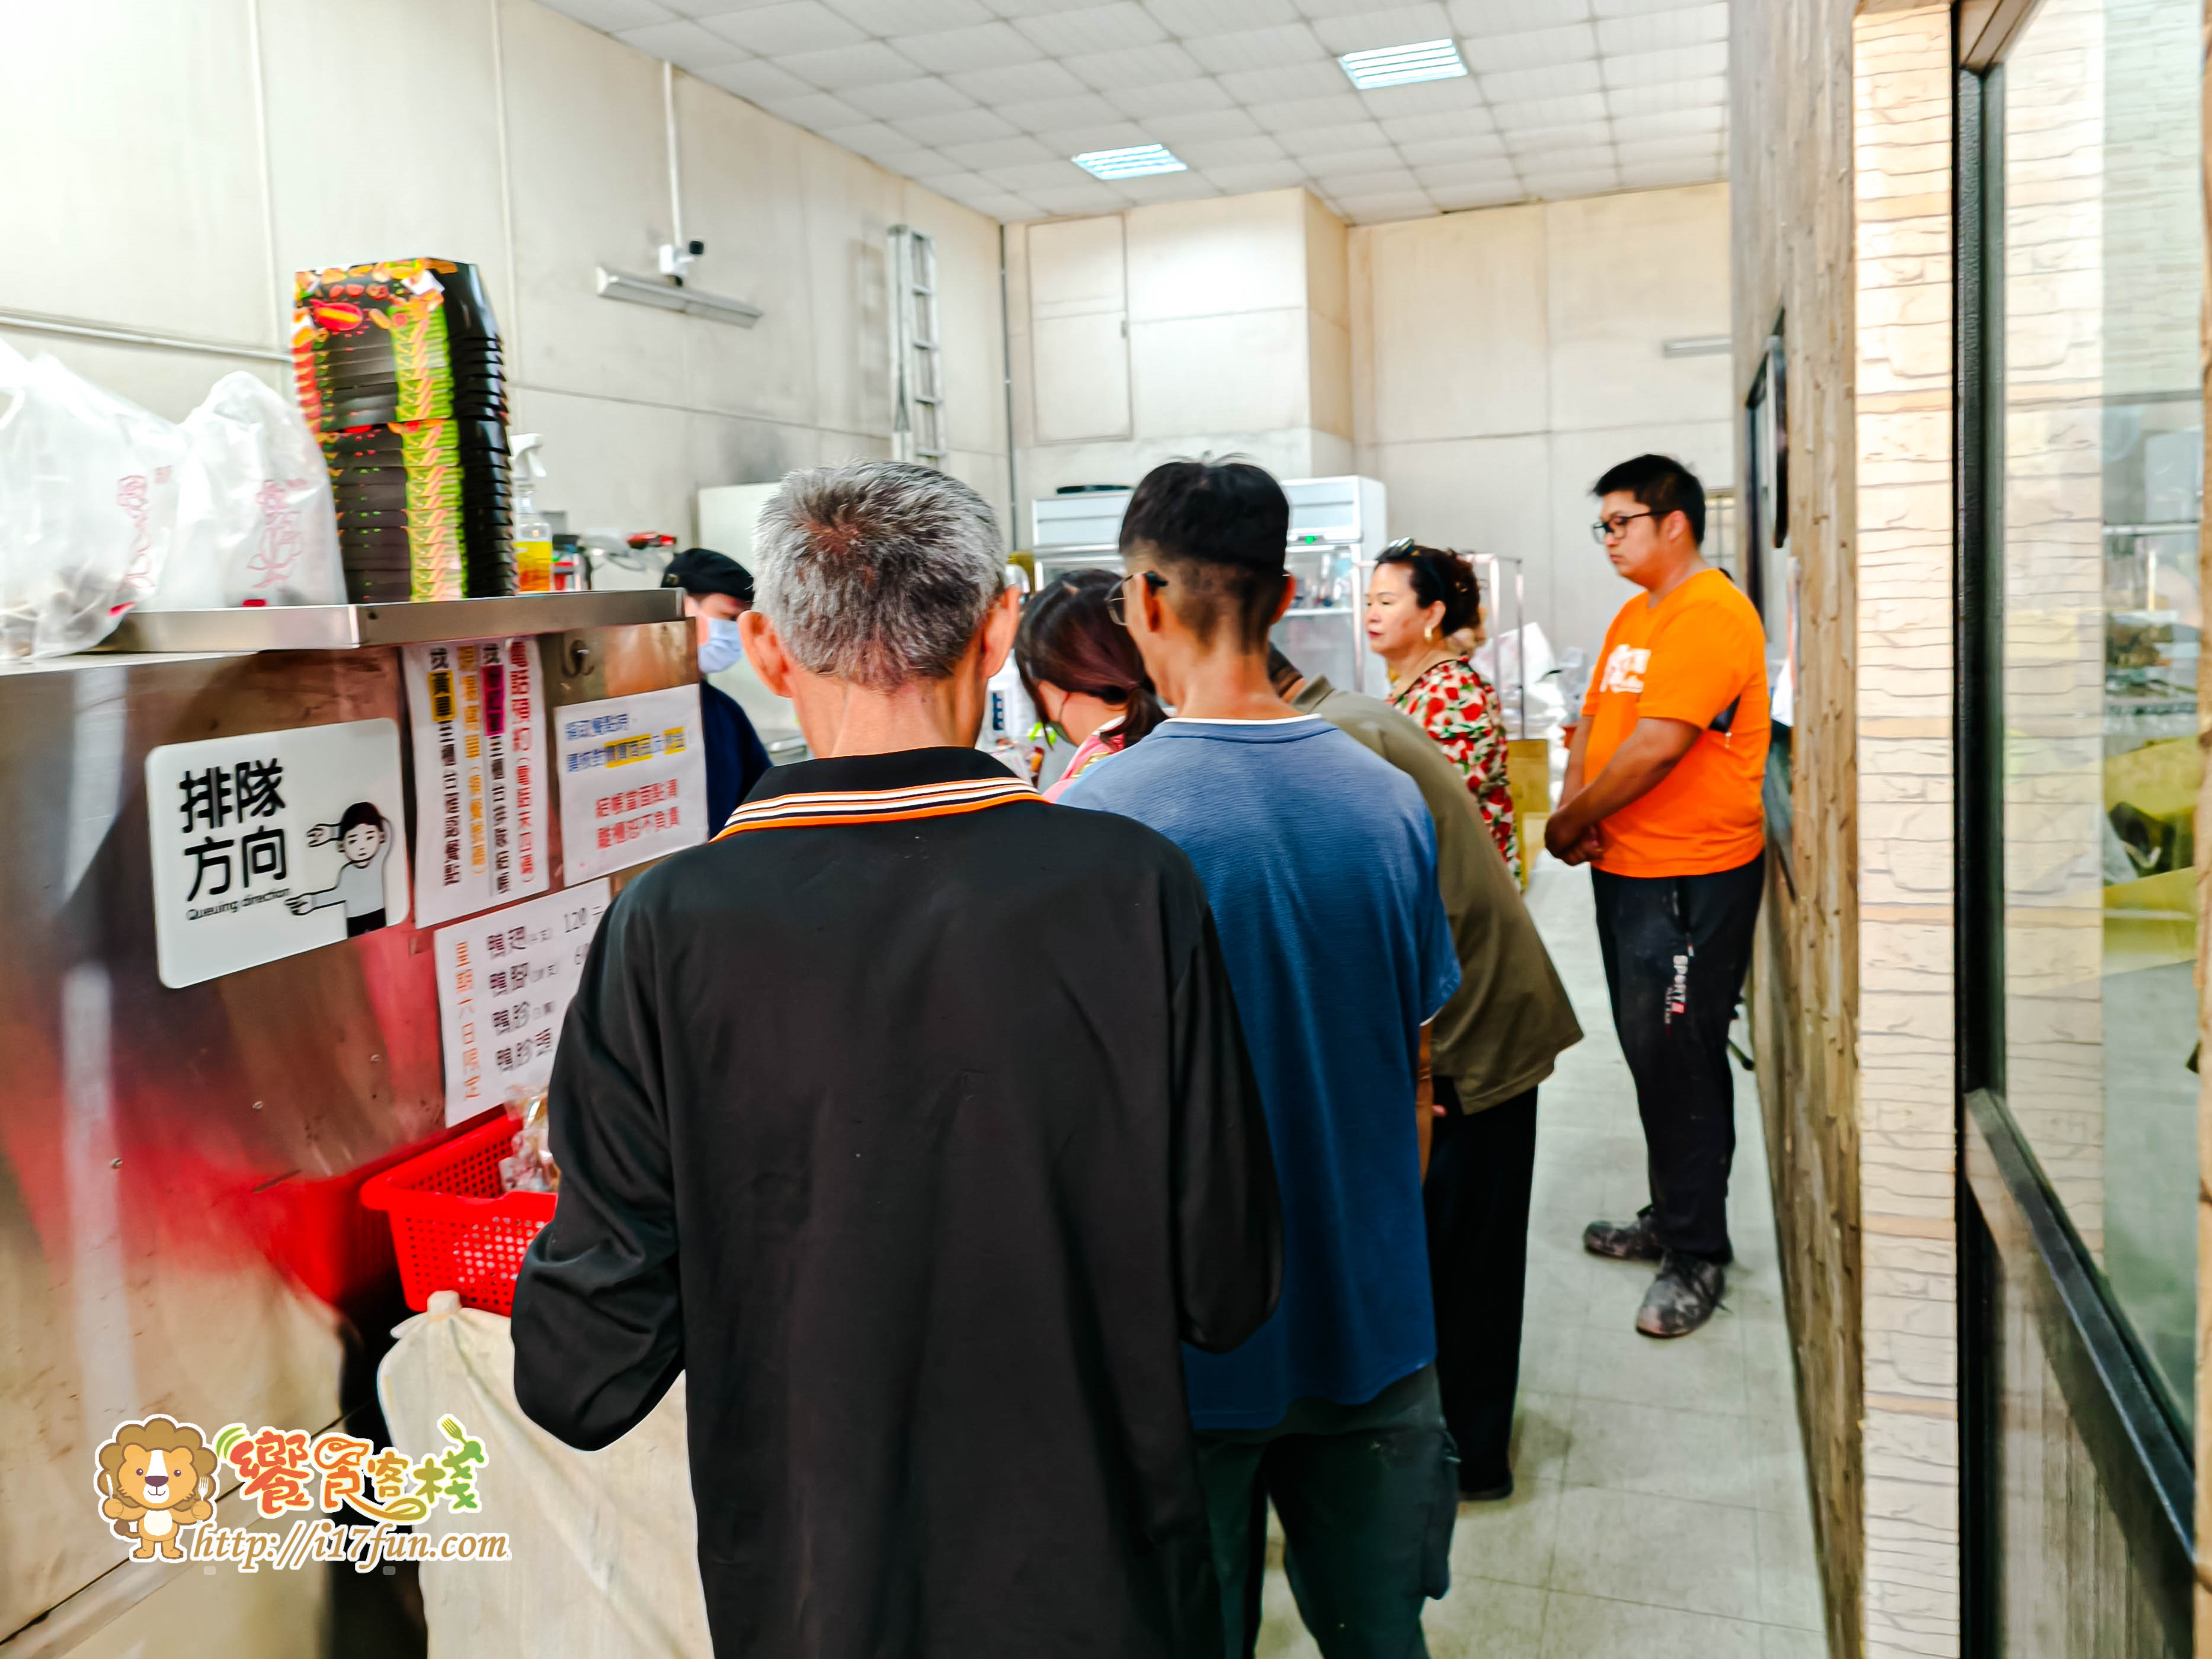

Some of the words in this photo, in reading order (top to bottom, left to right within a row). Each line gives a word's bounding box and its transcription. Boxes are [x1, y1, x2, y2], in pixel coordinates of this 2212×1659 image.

[180, 758, 286, 833] 排隊
[596, 779, 679, 819] 結帳當面點清
[596, 806, 680, 850] 離櫃恕不負責
[184, 825, 287, 902] 方向
[186, 900, 239, 920] Queuing
[241, 888, 290, 907] direction
